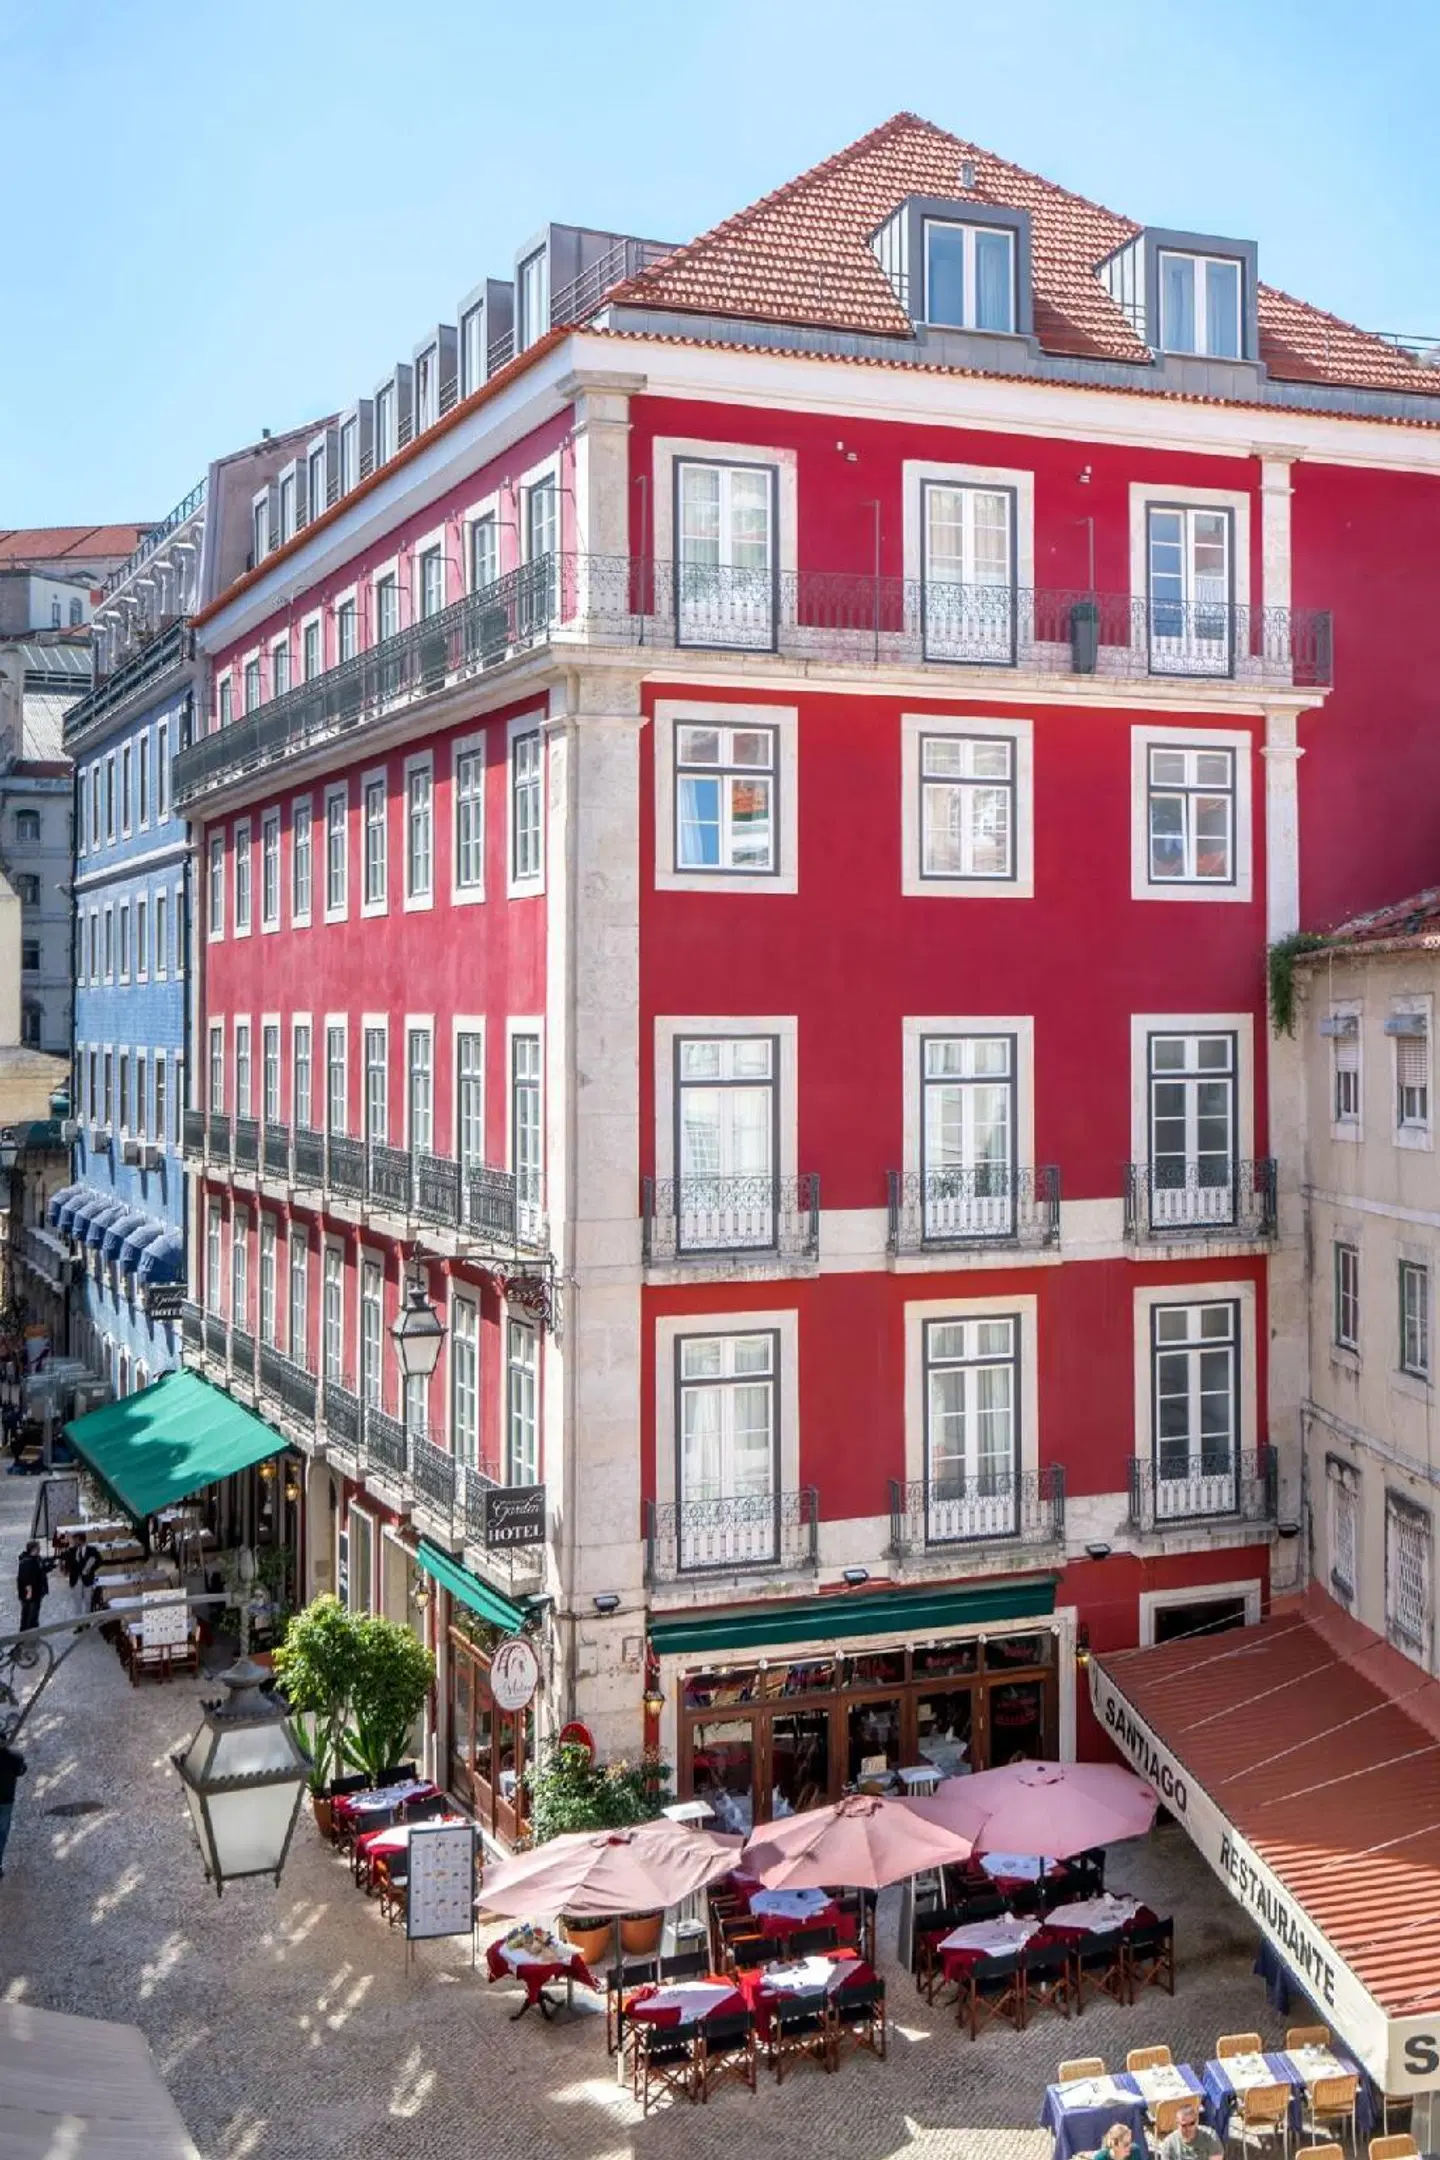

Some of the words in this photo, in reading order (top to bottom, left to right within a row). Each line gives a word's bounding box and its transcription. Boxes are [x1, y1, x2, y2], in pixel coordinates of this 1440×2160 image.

[488, 1524, 544, 1541] HOTEL
[1105, 1698, 1187, 1812] SANTIAGO
[1220, 1831, 1335, 2007] RESTAURANTE
